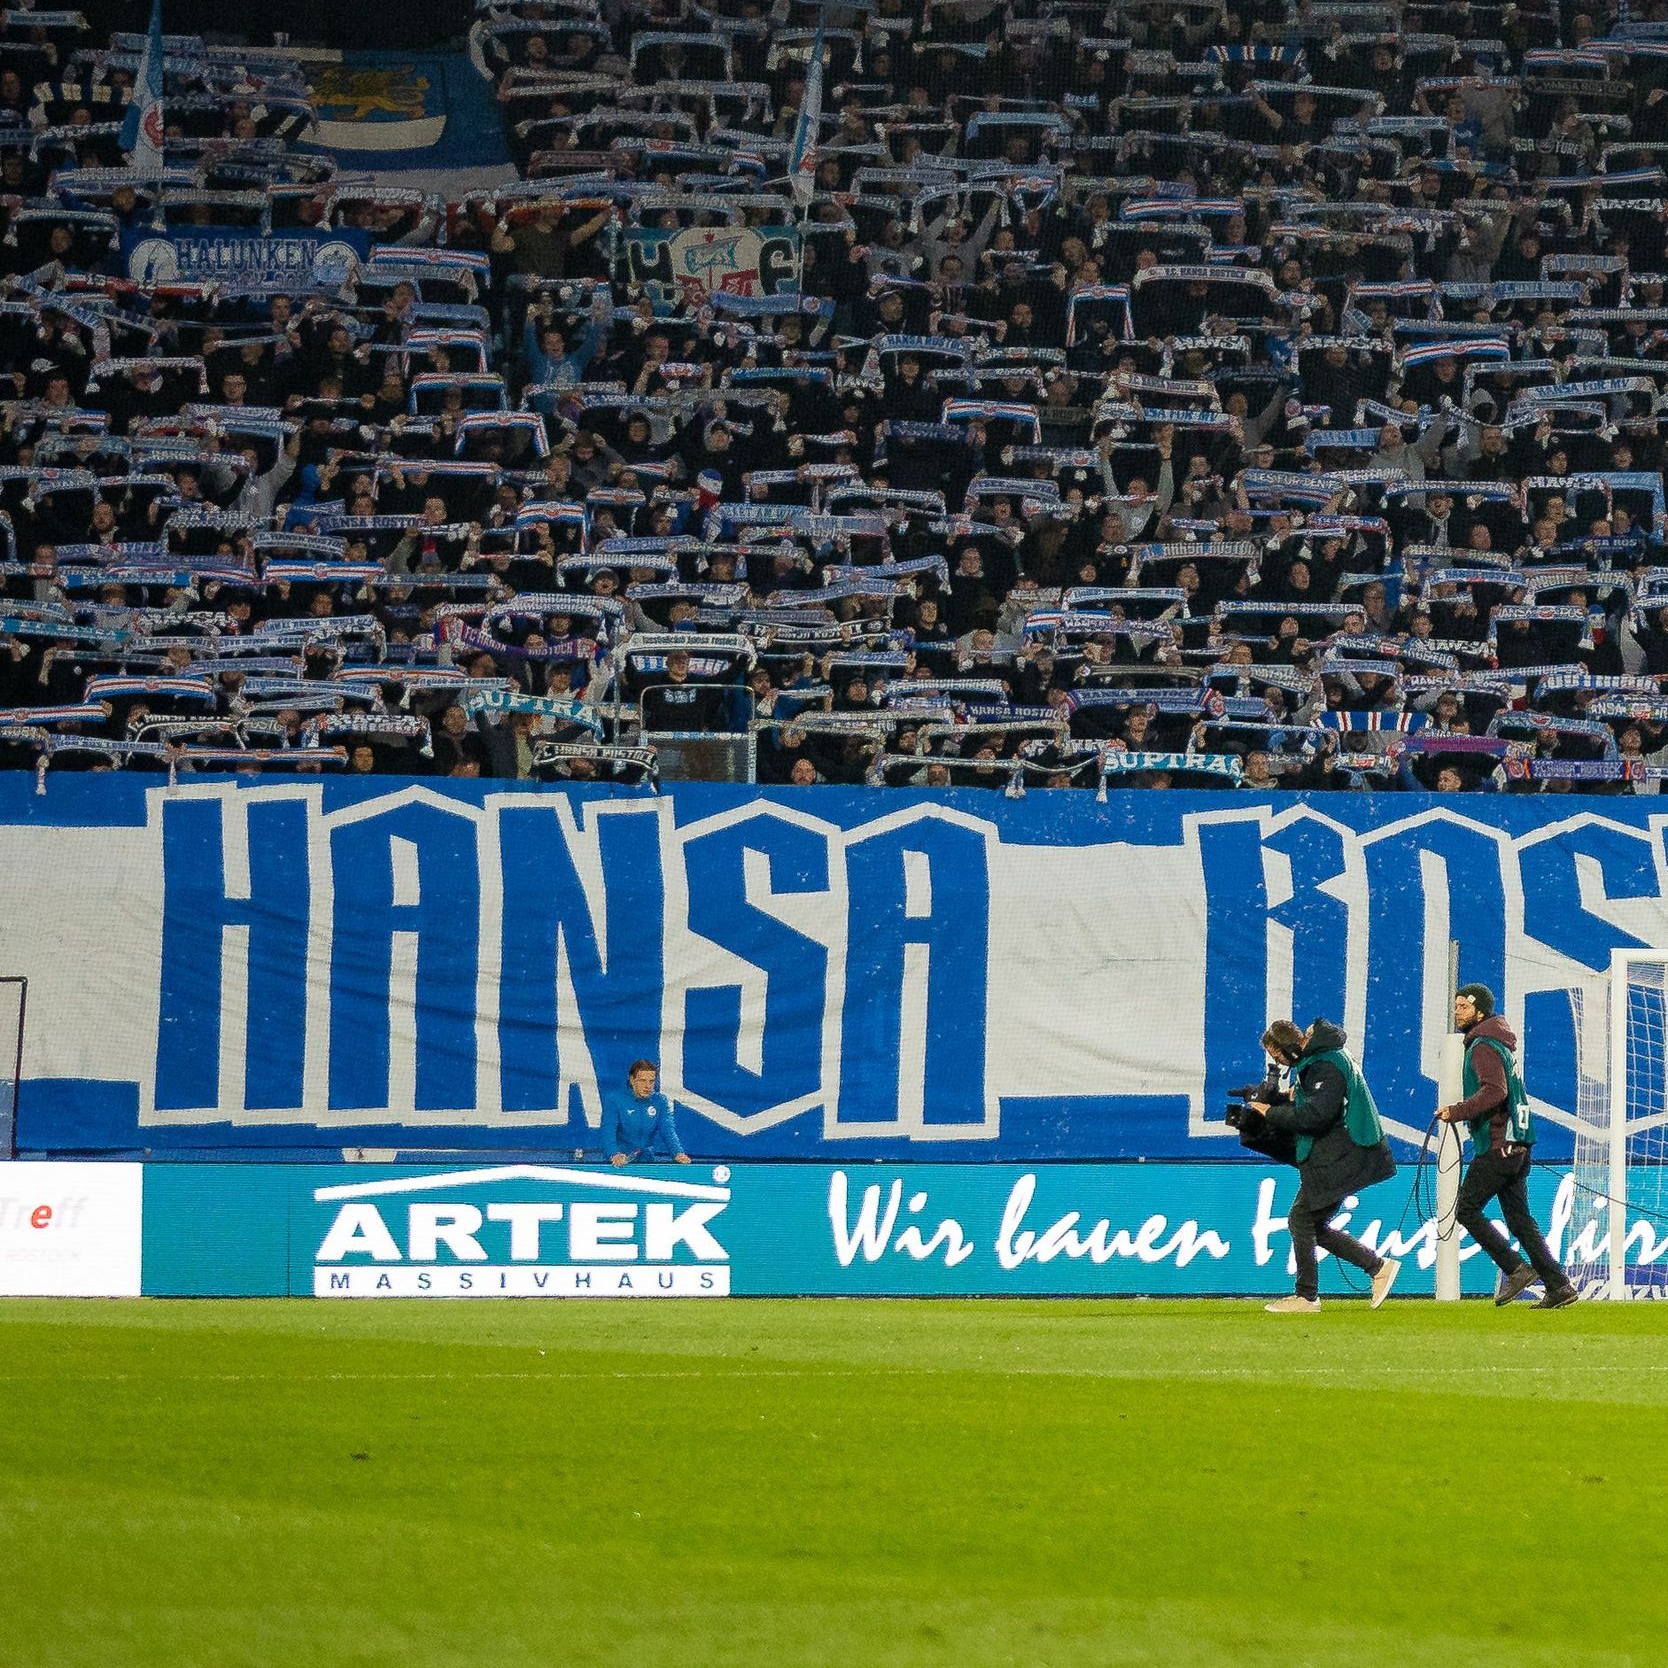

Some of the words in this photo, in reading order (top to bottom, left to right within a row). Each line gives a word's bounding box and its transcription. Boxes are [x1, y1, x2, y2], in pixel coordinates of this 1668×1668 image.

[175, 238, 319, 268] HALUNKEN
[1103, 753, 1243, 775] SUPTRAS
[142, 784, 998, 1138] HANSA
[316, 1203, 730, 1261] ARTEK
[828, 1170, 974, 1267] Wir
[996, 1173, 1231, 1269] bauen
[330, 1271, 717, 1290] MASSIVHAUS
